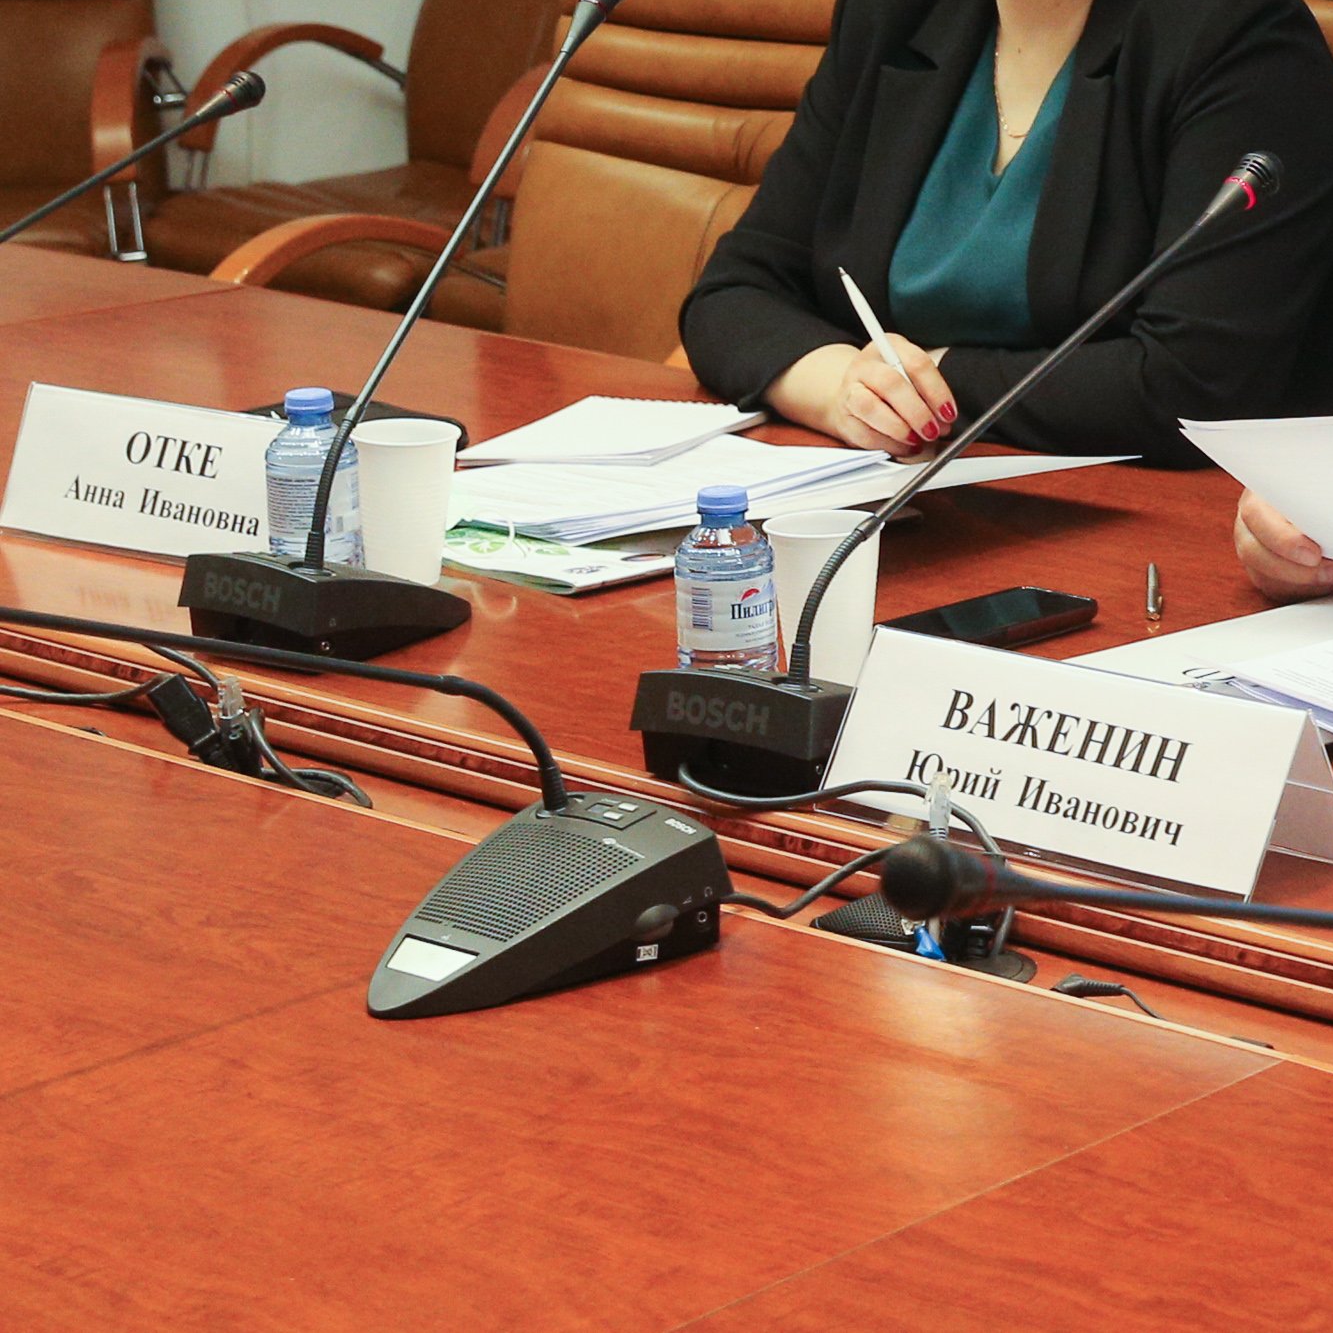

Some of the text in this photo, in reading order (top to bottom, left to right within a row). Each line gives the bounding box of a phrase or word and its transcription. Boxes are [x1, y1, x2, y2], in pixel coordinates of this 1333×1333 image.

[126, 431, 223, 479] ОТКЕ
[64, 474, 125, 509] Анна
[138, 487, 260, 536] Ивановна
[202, 571, 282, 612] BOSCH
[666, 690, 770, 736] BOSCH
[939, 689, 1193, 783] ВАЖЕНИН
[904, 749, 1184, 846] Юрий Иванович
[664, 818, 697, 834] BOSCH
